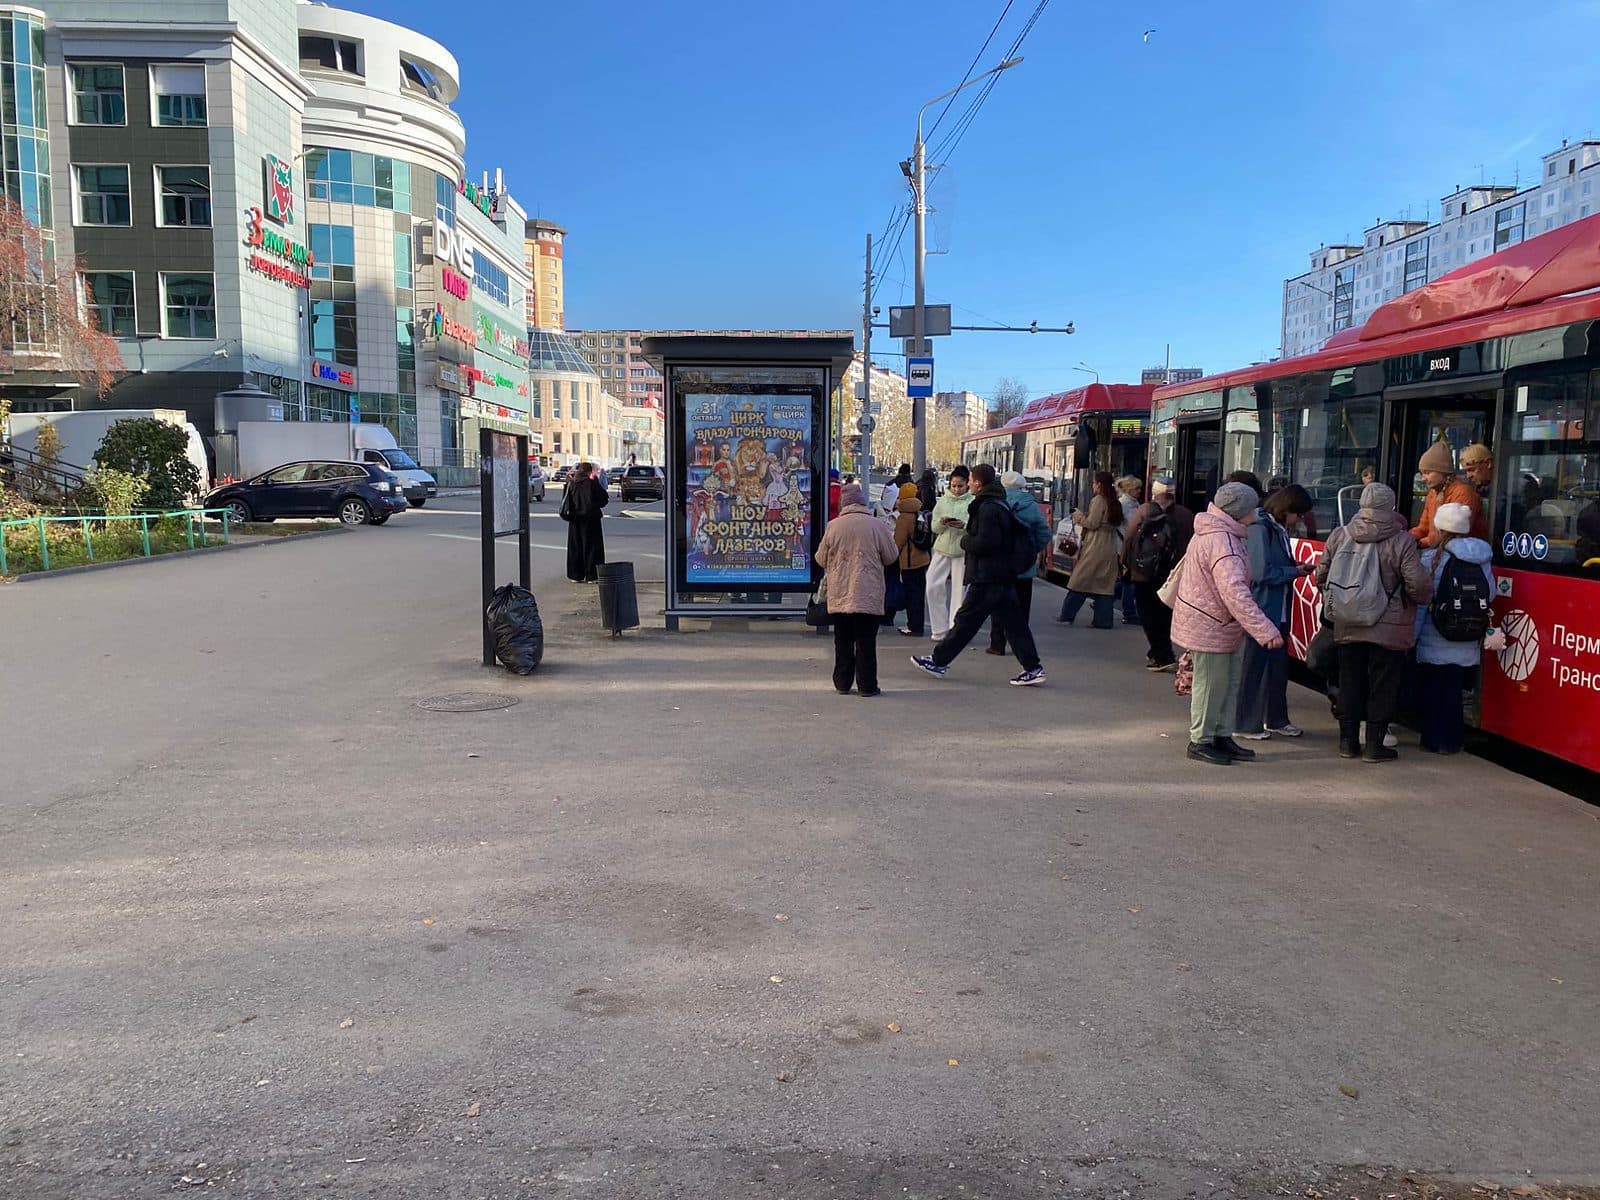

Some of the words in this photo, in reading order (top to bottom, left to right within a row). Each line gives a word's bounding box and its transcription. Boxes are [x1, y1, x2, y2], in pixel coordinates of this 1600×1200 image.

[436, 218, 474, 279] DNS
[1430, 356, 1450, 371] ВХОД
[702, 402, 717, 414] 31
[782, 411, 806, 420] ЦИРК
[730, 411, 766, 426] ЦИРК
[696, 427, 733, 441] ВЛАДА
[735, 426, 803, 441] ГОНЧАРОВА
[731, 504, 767, 521] ШОУ
[703, 521, 796, 537] ФОНТАНОВ
[712, 538, 786, 555] ЛАЗЕРОВ
[1553, 623, 1600, 657] Перм
